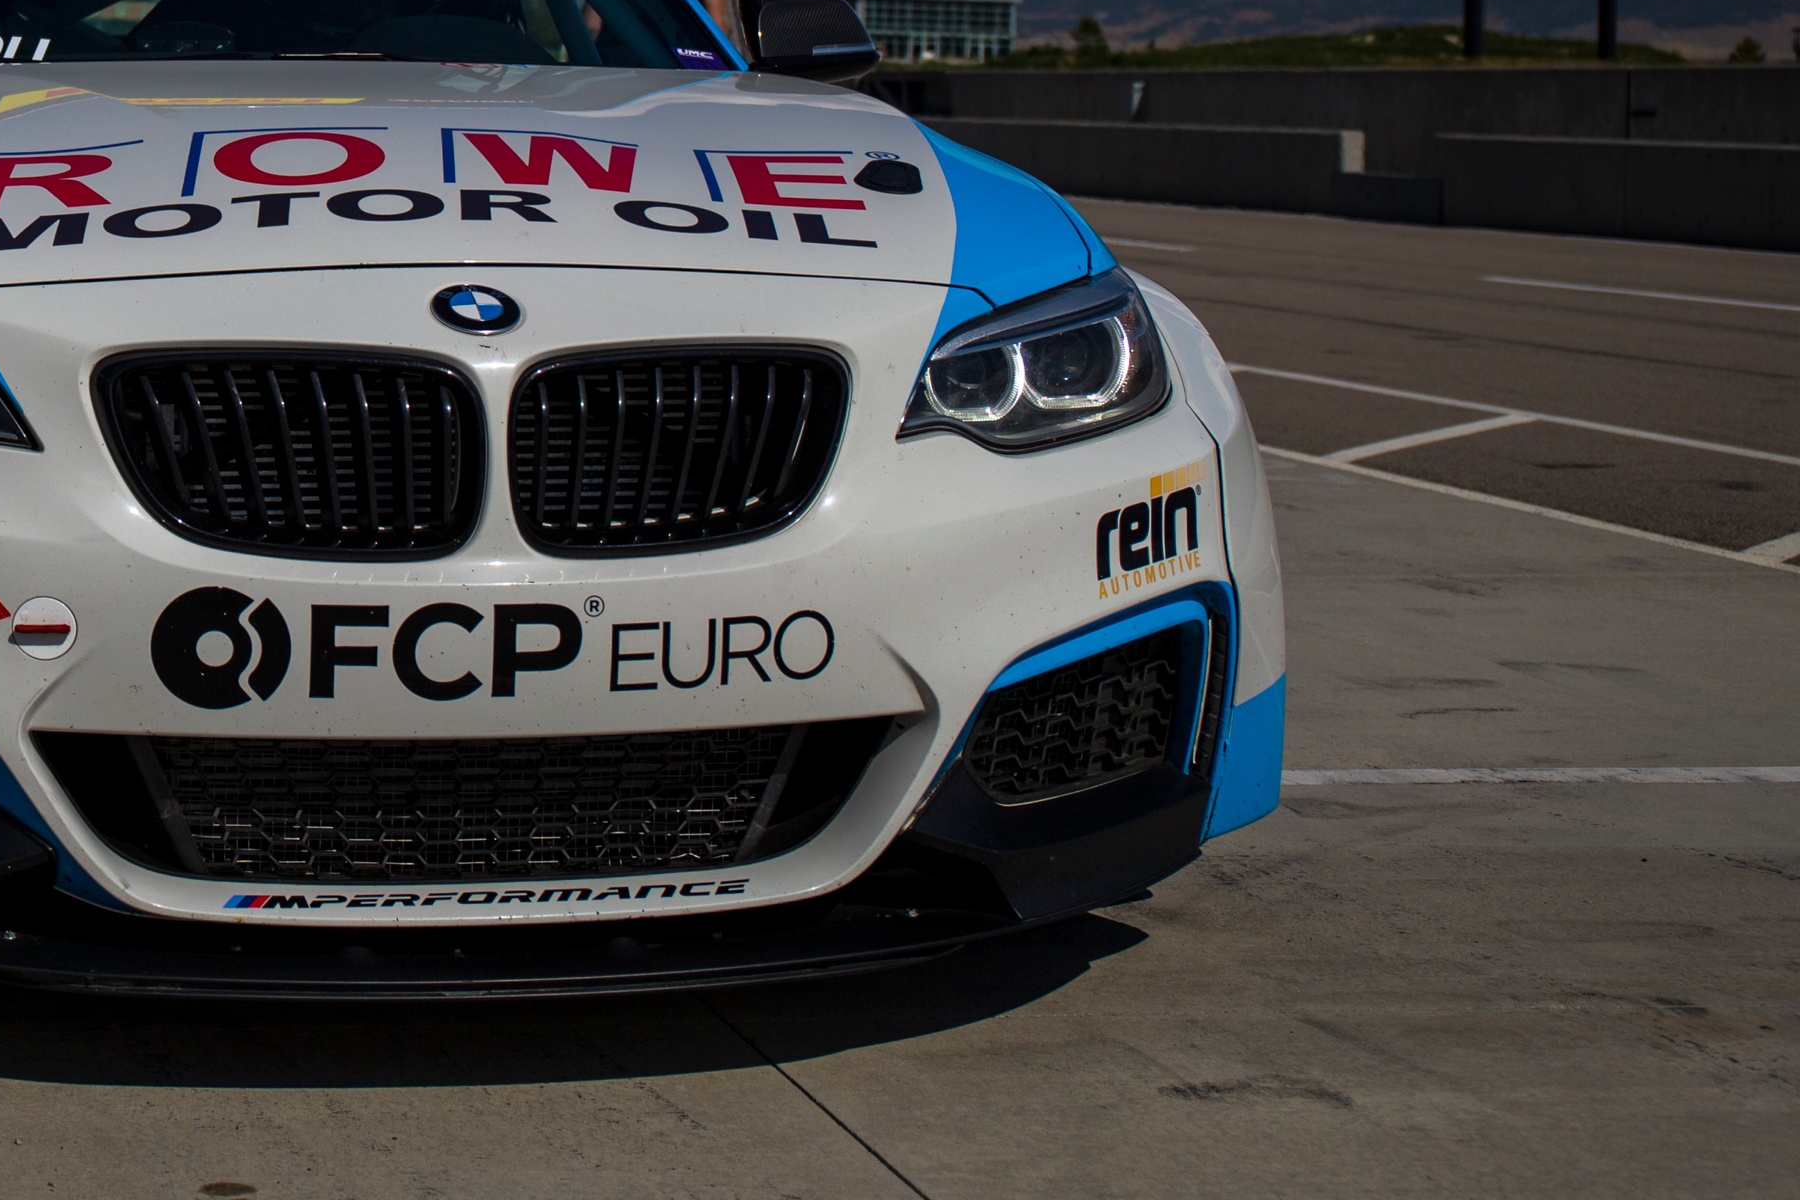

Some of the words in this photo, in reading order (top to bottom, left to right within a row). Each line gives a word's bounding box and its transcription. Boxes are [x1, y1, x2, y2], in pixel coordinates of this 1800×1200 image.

[677, 47, 714, 60] UMC
[613, 200, 878, 248] OIL
[1096, 476, 1199, 581] rein
[1099, 550, 1201, 600] AUTOMOTIVE
[308, 602, 583, 701] FCP
[610, 610, 835, 692] EURO
